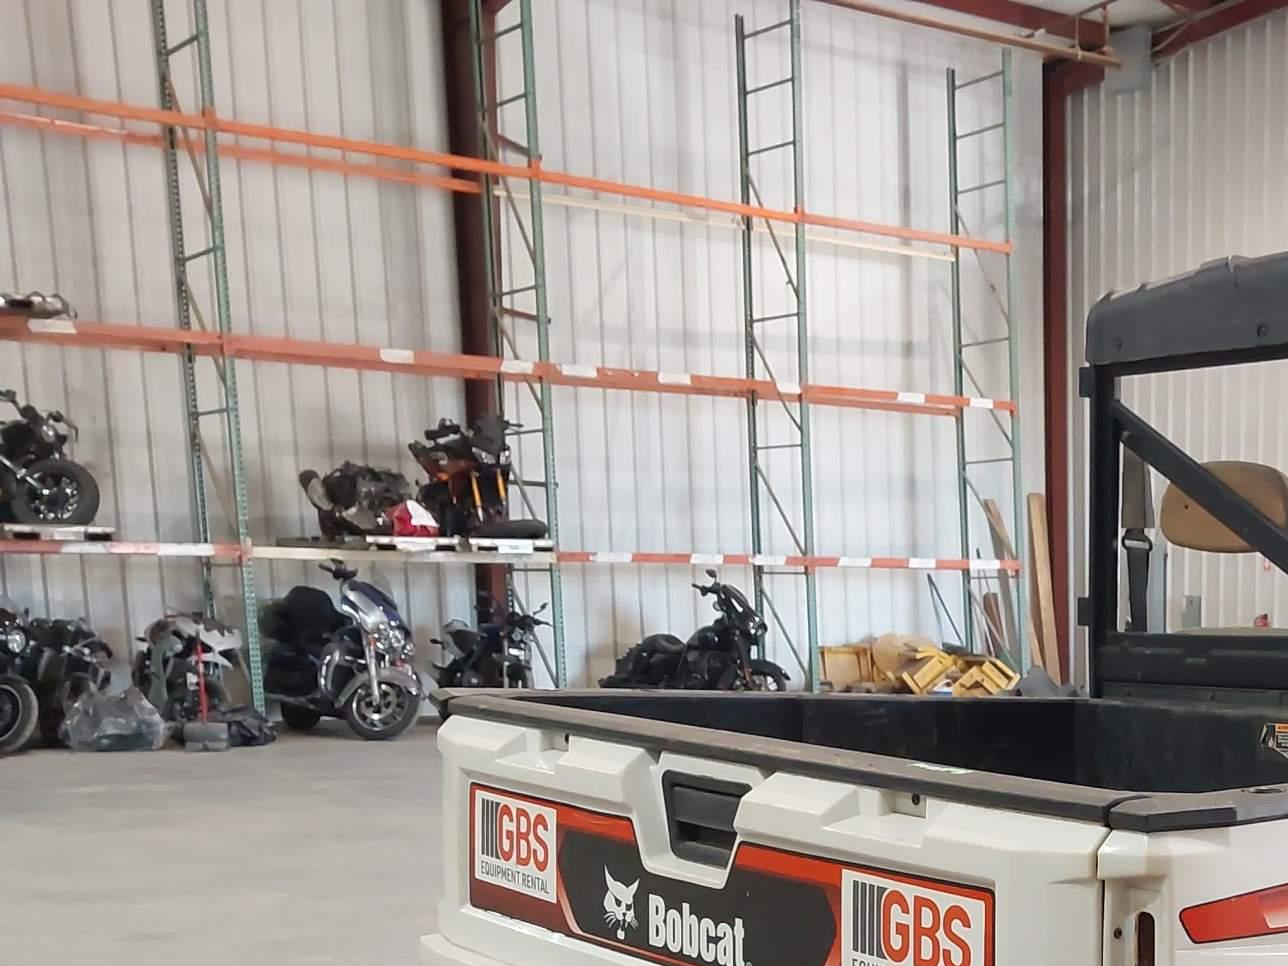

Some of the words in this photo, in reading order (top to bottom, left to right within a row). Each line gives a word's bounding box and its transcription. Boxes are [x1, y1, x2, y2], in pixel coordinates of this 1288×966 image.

[498, 803, 549, 872] GBS
[481, 860, 521, 885] EQUIPMENT
[521, 872, 550, 894] RENTAL
